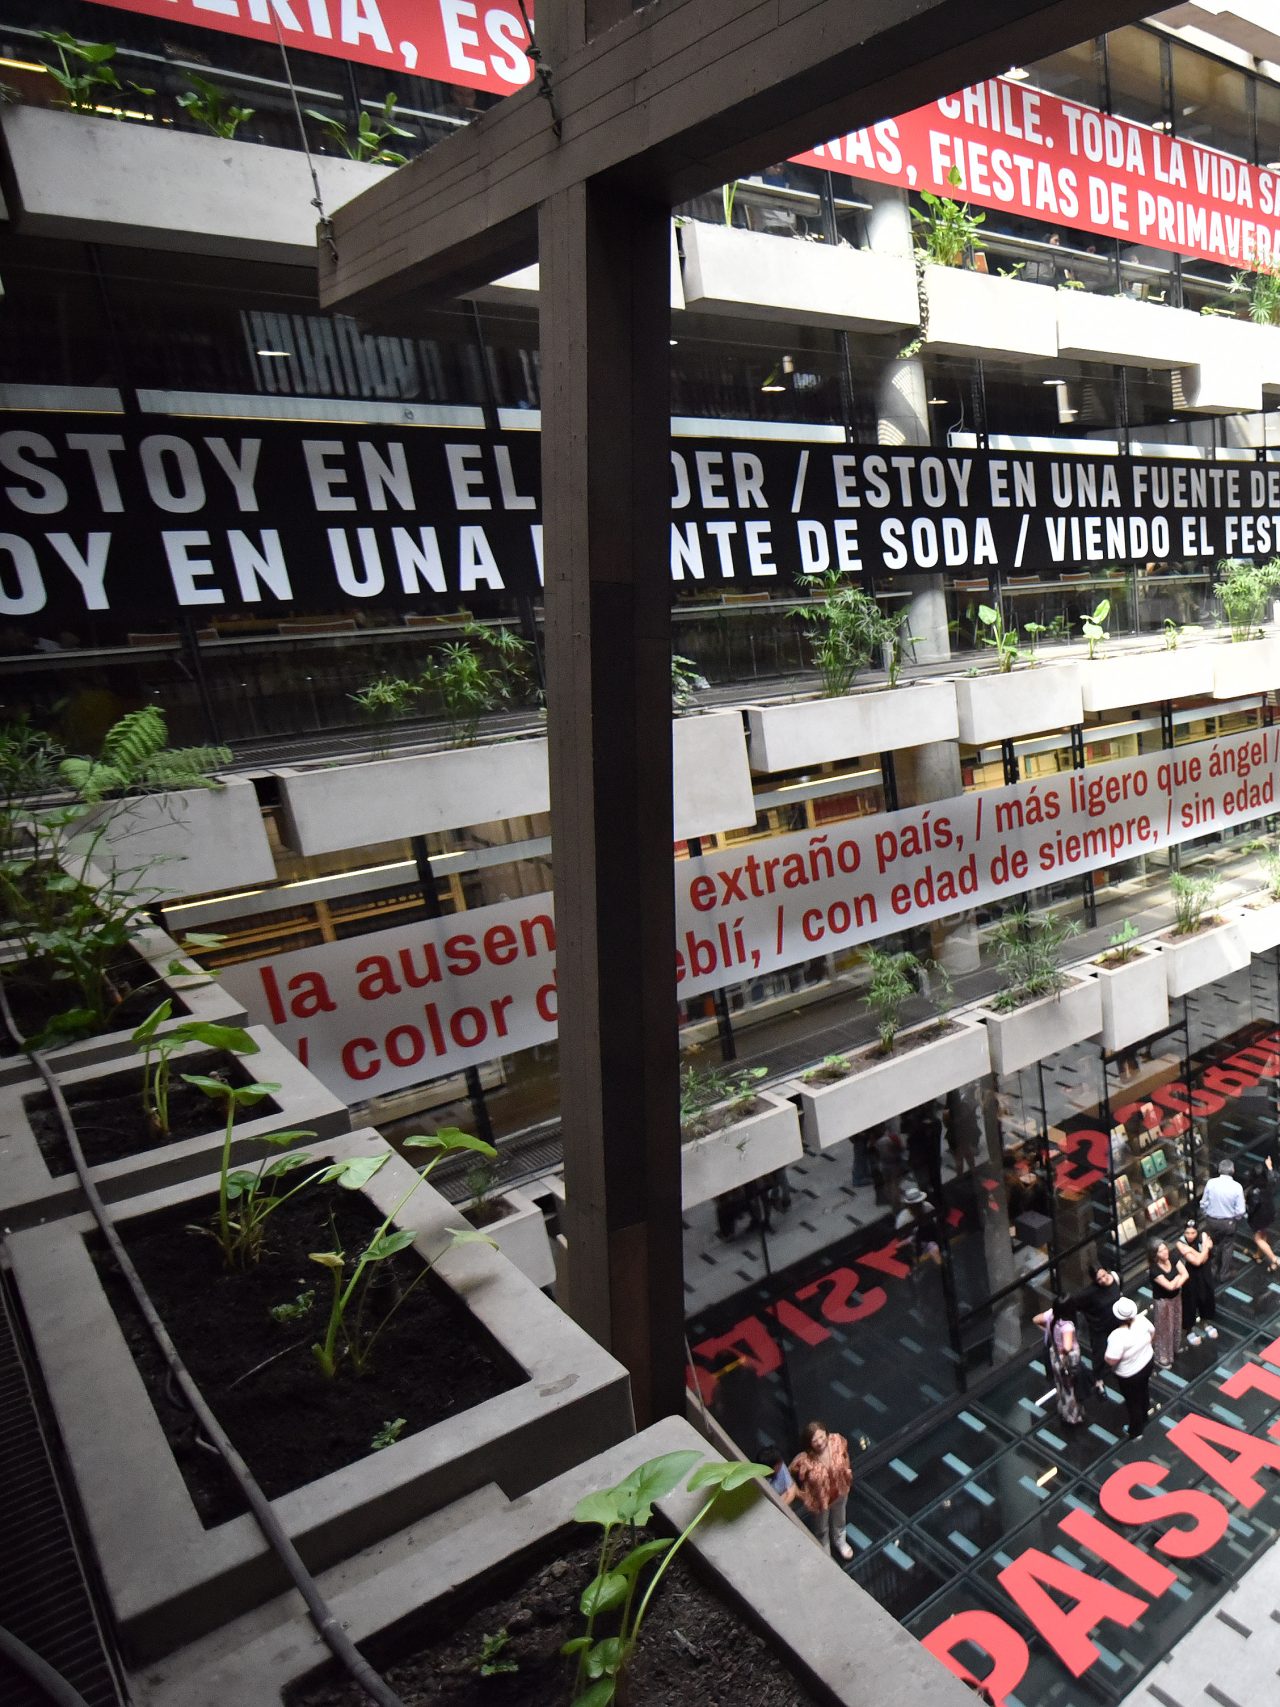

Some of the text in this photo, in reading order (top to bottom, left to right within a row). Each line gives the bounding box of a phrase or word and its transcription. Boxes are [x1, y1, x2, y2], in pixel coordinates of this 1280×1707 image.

[439, 0, 535, 85] ES
[929, 130, 1079, 218] FIESTAS
[1088, 176, 1129, 231] DE
[1062, 104, 1145, 176] TODA
[1153, 136, 1187, 188] LA
[1193, 149, 1253, 208] VIDA
[0, 430, 262, 515] STOY
[301, 439, 416, 511] EN
[444, 444, 536, 510] EL
[832, 454, 972, 509] ESTOY
[988, 459, 1037, 508] EN
[1050, 462, 1121, 508] UNA
[1132, 465, 1240, 509] FUENTE
[1250, 470, 1280, 509] DE
[161, 529, 294, 606] EN
[327, 525, 506, 598] UNA
[796, 519, 863, 574] DE
[880, 517, 998, 570] SODA
[1045, 515, 1170, 562] VIENDO
[1182, 516, 1214, 557] EL
[259, 965, 337, 1025] la
[355, 914, 556, 1000] ausen
[690, 834, 860, 912] extraño
[875, 810, 963, 874] país,
[995, 785, 1061, 833] más
[1069, 770, 1148, 817] ligero
[1157, 756, 1202, 796] que
[1209, 732, 1268, 778] ángel
[341, 994, 513, 1080] color
[802, 893, 877, 942] con
[891, 853, 978, 915] edad
[990, 845, 1028, 885] de
[1039, 815, 1158, 871] siempre,
[1181, 792, 1215, 828] sin
[1223, 773, 1273, 815] edad
